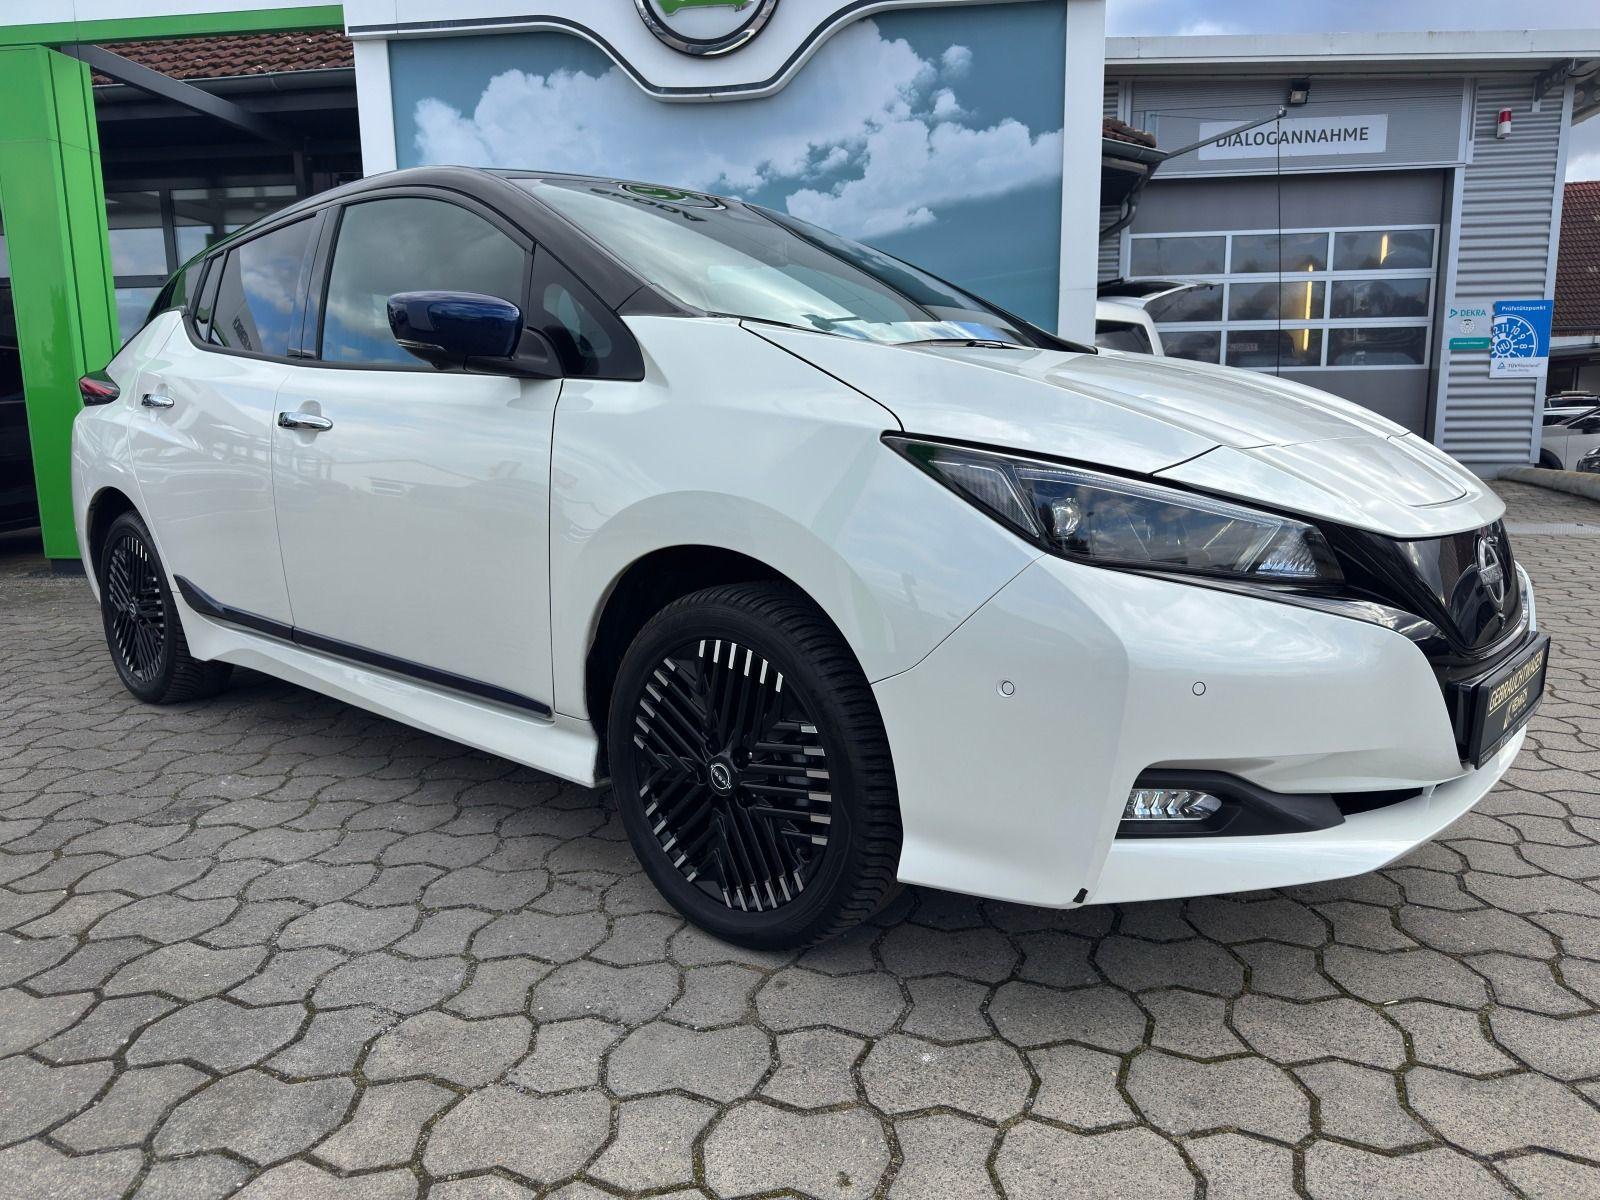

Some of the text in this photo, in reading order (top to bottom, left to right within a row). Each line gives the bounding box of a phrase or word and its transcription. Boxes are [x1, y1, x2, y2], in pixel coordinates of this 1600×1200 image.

[1216, 127, 1369, 148] DIALOGANNAHME
[1460, 309, 1487, 317] DEKRA
[1510, 325, 1521, 335] 10
[1497, 341, 1510, 353] HU
